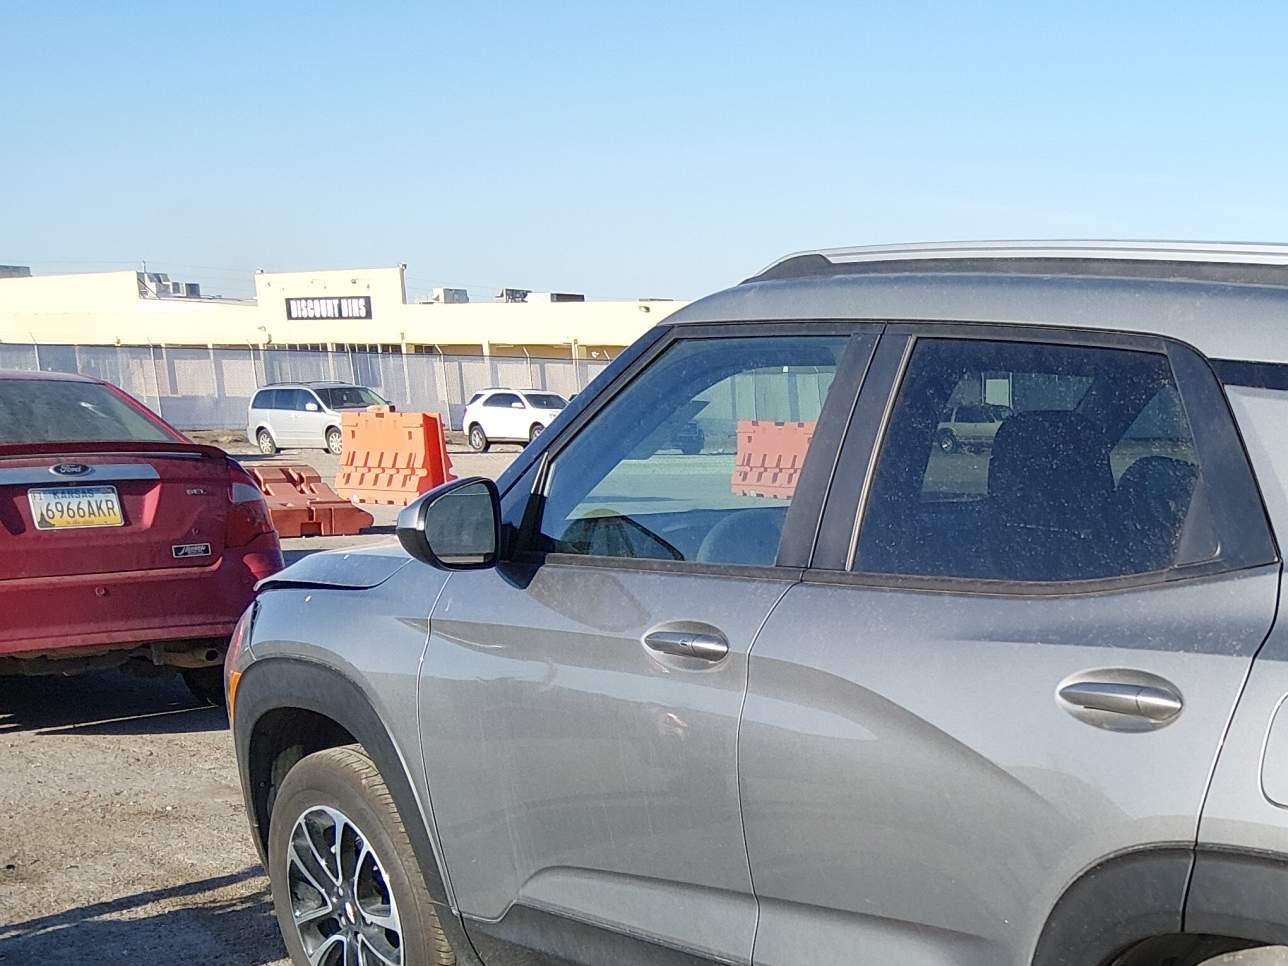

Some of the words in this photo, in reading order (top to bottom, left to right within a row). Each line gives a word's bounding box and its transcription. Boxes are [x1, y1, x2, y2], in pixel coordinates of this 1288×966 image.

[289, 298, 340, 318] DISCOUNT
[340, 298, 366, 318] BINS
[59, 463, 82, 474] Ford
[53, 488, 95, 499] KANSAS
[45, 499, 117, 520] 6966AKR
